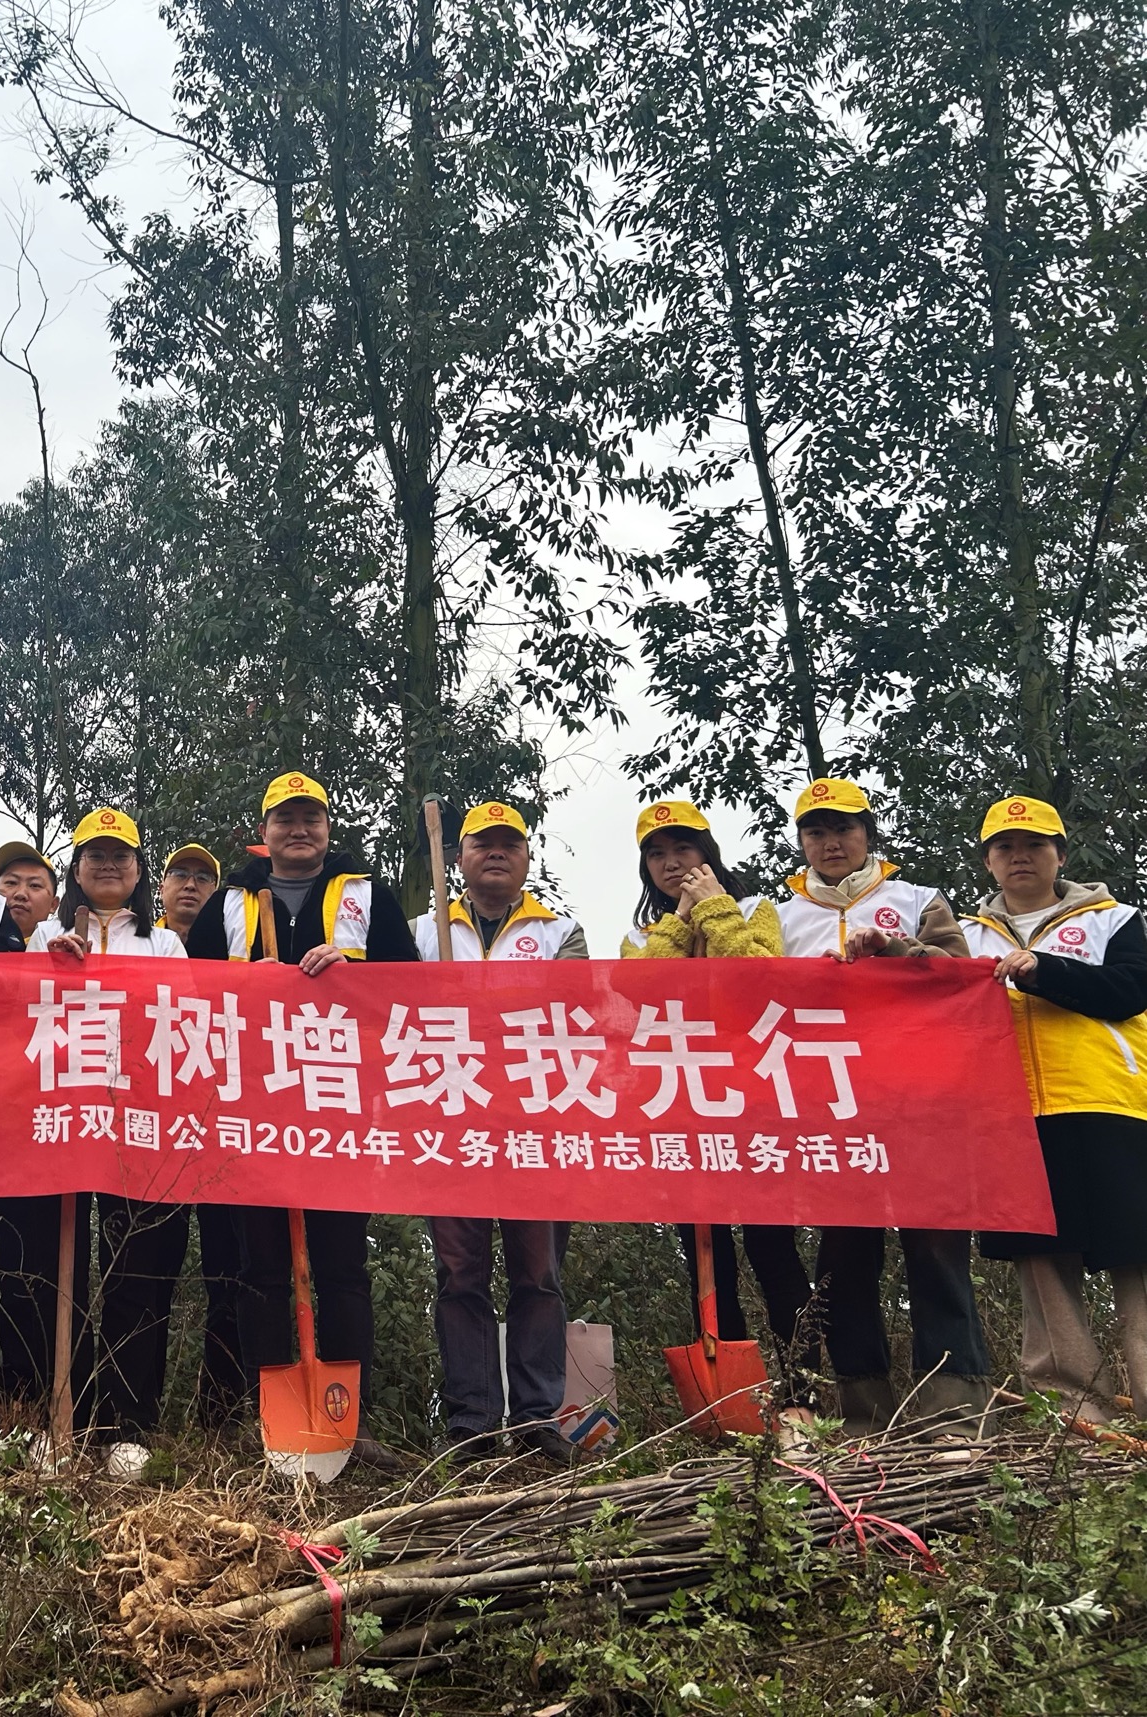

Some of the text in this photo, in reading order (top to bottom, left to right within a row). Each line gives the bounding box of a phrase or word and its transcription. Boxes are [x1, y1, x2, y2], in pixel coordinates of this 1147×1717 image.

[1048, 945, 1090, 959] 大足志愿者
[24, 979, 862, 1120] 植树增绿我先行
[32, 1104, 891, 1174] 新双圈公司2024年义务植树志愿服务活动
